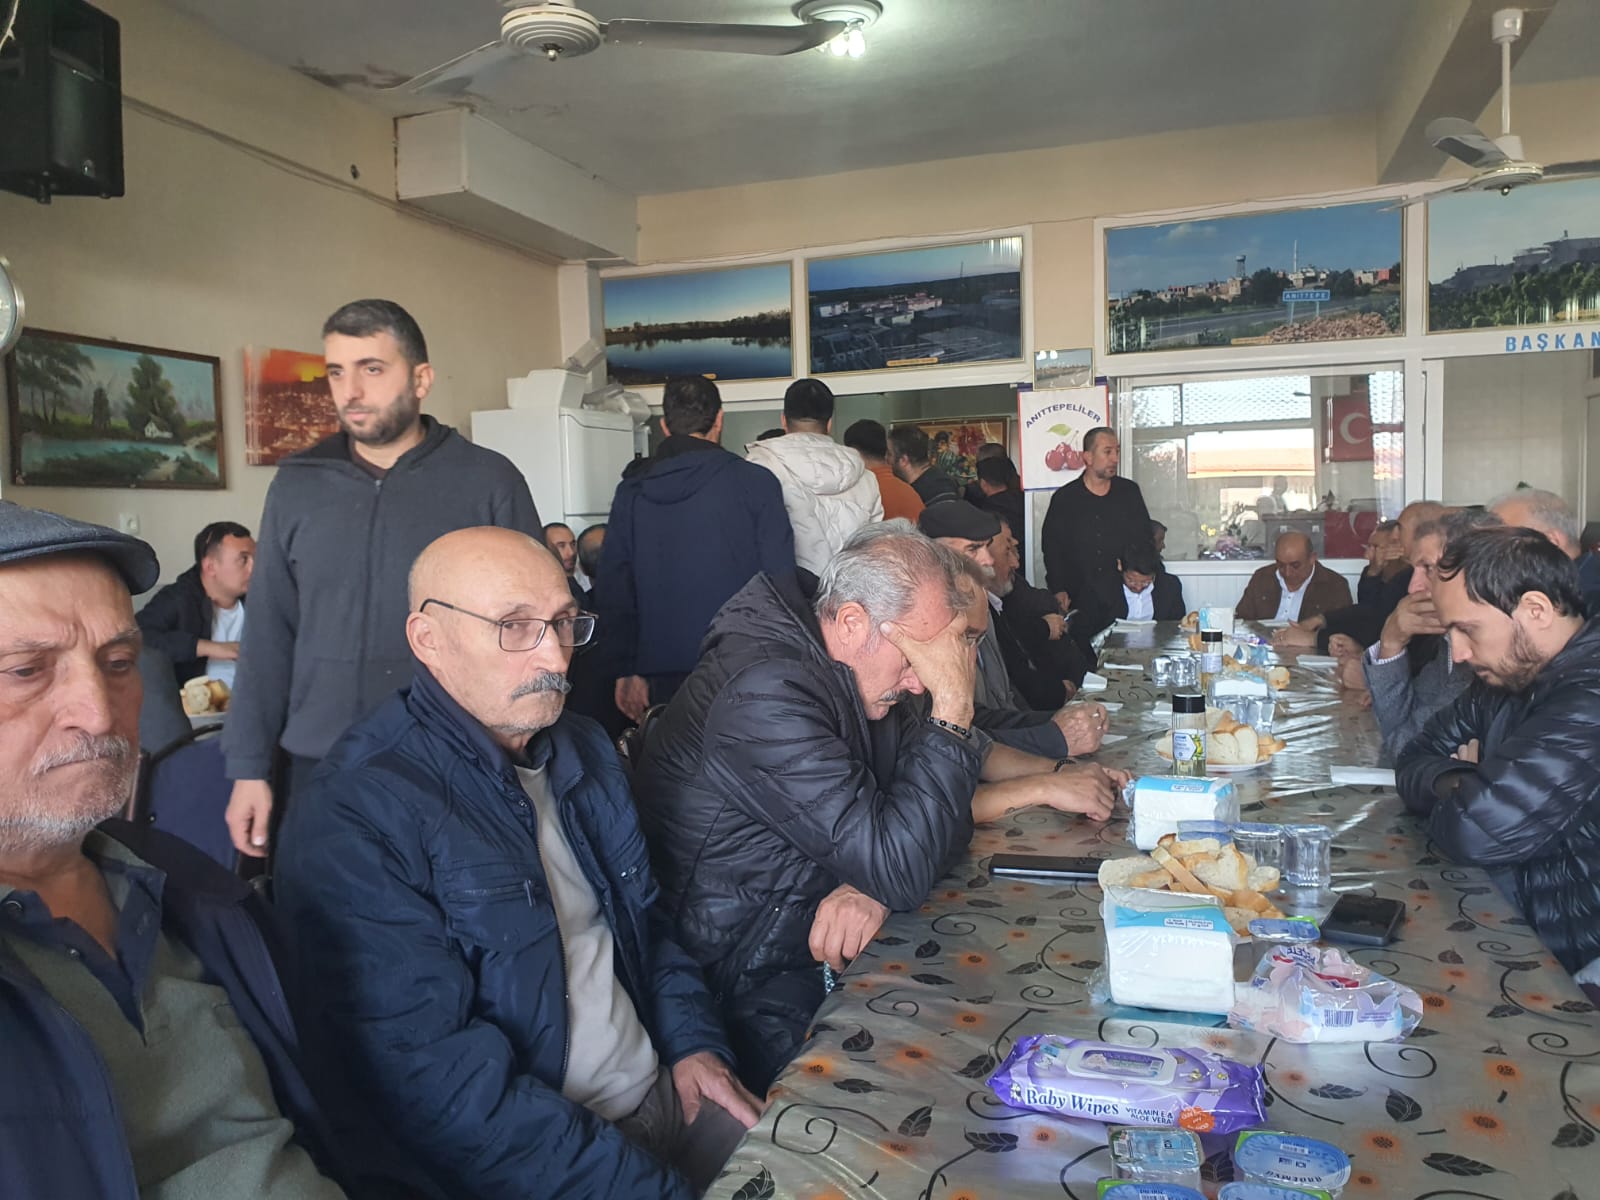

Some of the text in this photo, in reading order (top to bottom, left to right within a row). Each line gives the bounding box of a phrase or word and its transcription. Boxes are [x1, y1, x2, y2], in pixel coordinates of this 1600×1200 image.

[1506, 331, 1600, 352] BAŞKAN
[1026, 403, 1101, 428] ANITTEPELİLER
[1025, 1089, 1119, 1115] Baby Wipes
[1125, 1108, 1159, 1117] VITAMIN
[1131, 1113, 1172, 1124] ALOE VERA
